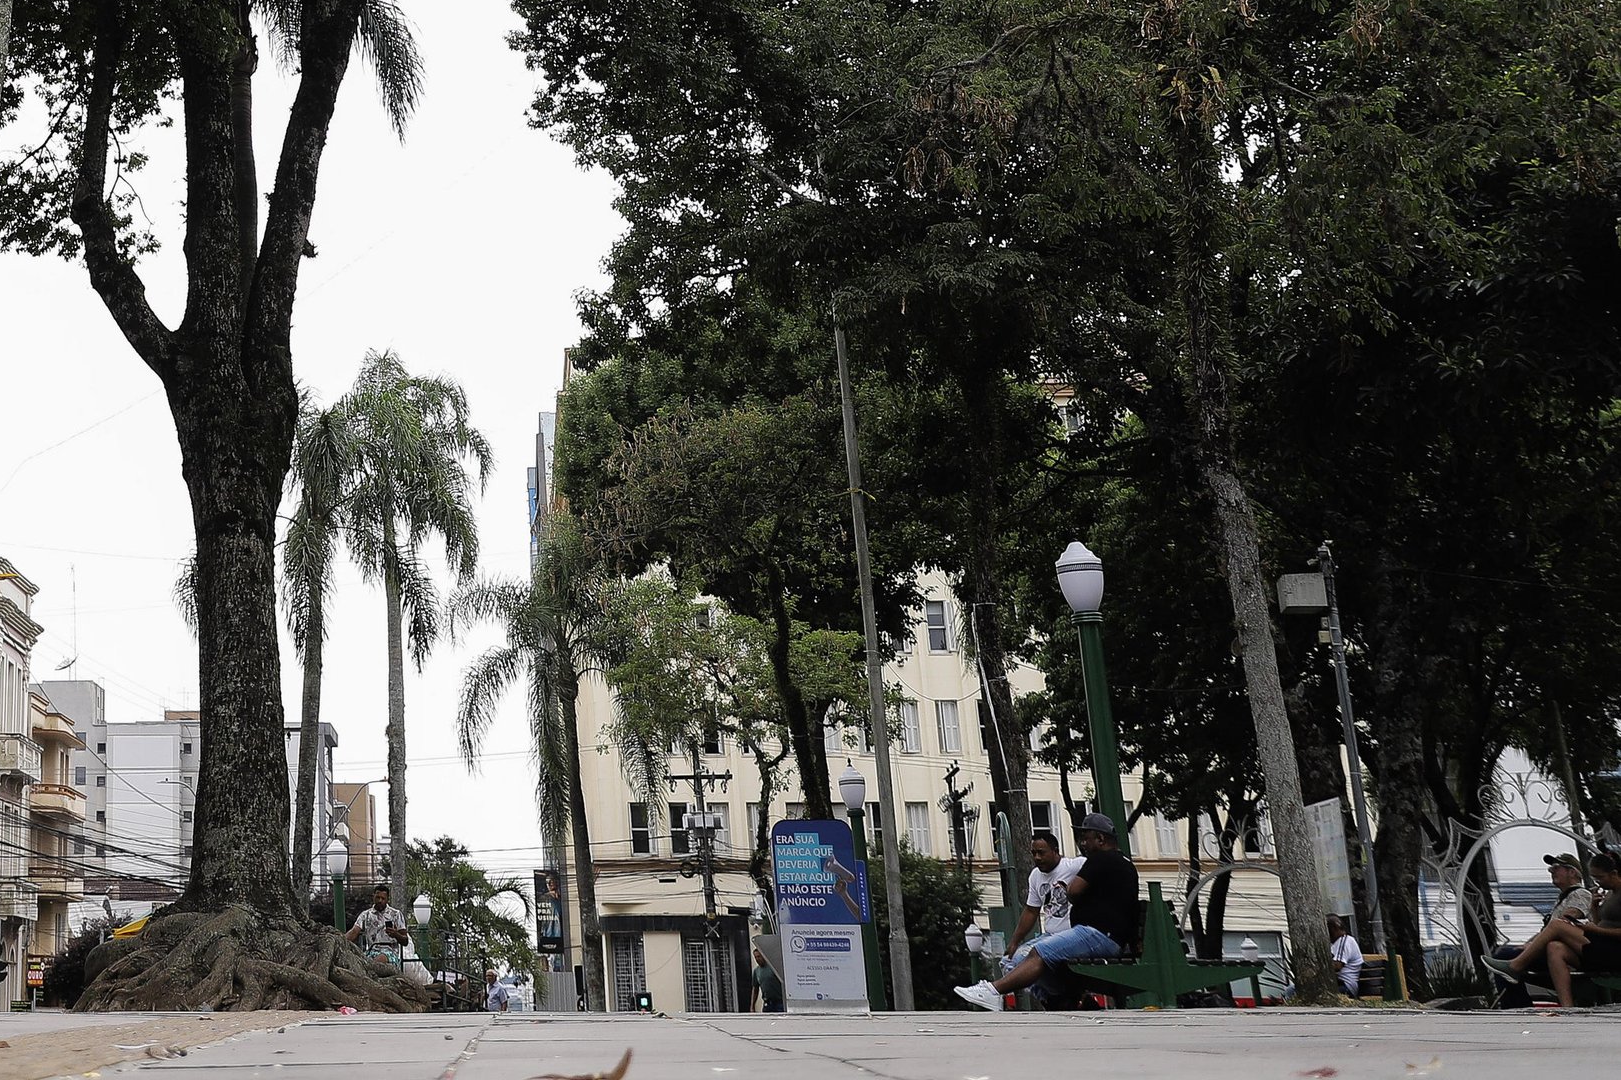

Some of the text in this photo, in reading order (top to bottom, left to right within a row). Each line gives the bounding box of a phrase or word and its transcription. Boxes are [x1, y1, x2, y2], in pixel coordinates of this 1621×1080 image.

[775, 835, 815, 844] ERA SUA
[777, 847, 834, 858] MARCA QUE
[778, 860, 819, 869] DEVERIA
[779, 872, 833, 883] ESTAR AQUI
[780, 883, 833, 894] E NÃO ESTE
[780, 896, 826, 907] ANÚNCIO
